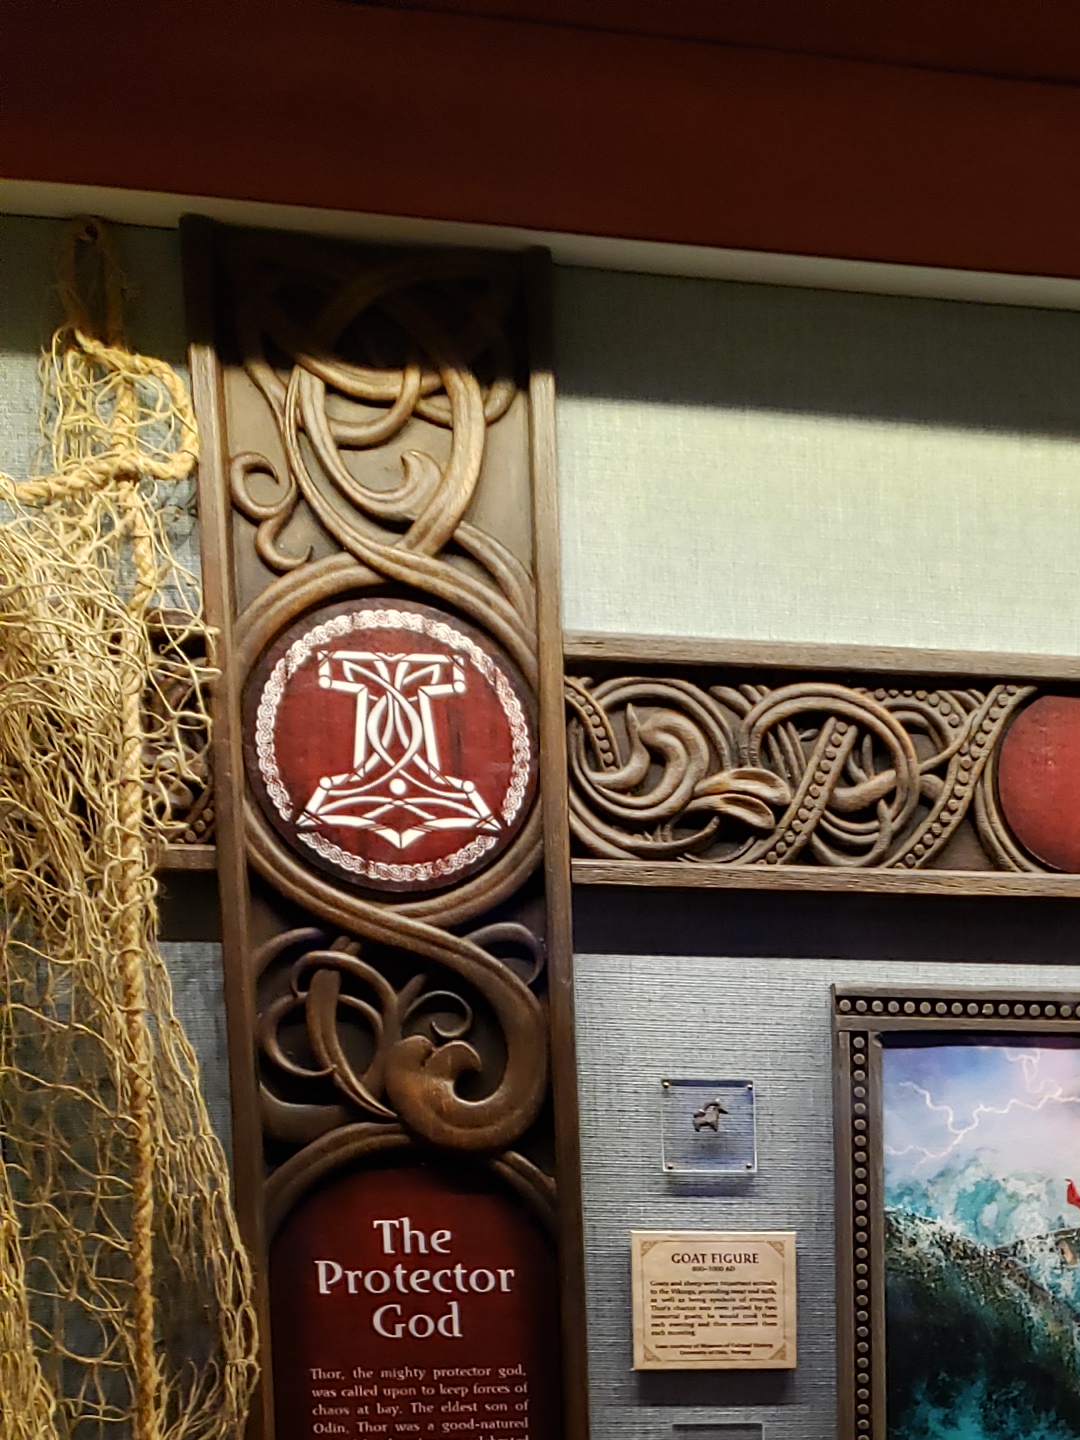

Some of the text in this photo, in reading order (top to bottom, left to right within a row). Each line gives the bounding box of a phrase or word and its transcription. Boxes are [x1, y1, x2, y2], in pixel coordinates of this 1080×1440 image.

[372, 1217, 452, 1254] The
[671, 1253, 760, 1264] GOAT FIGURE
[314, 1260, 515, 1294] Protector
[372, 1301, 464, 1338] God
[352, 1368, 374, 1378] the
[380, 1367, 426, 1381] mighty
[432, 1366, 492, 1380] protector
[311, 1384, 528, 1399] was called upon to keep forces of
[311, 1405, 350, 1415] chaos
[356, 1404, 370, 1414] at
[411, 1403, 435, 1413] The
[440, 1402, 478, 1413] eldest
[484, 1404, 508, 1412] son
[514, 1401, 529, 1411] of
[357, 1422, 388, 1432] Thor
[394, 1424, 421, 1432] was
[426, 1423, 435, 1431] a
